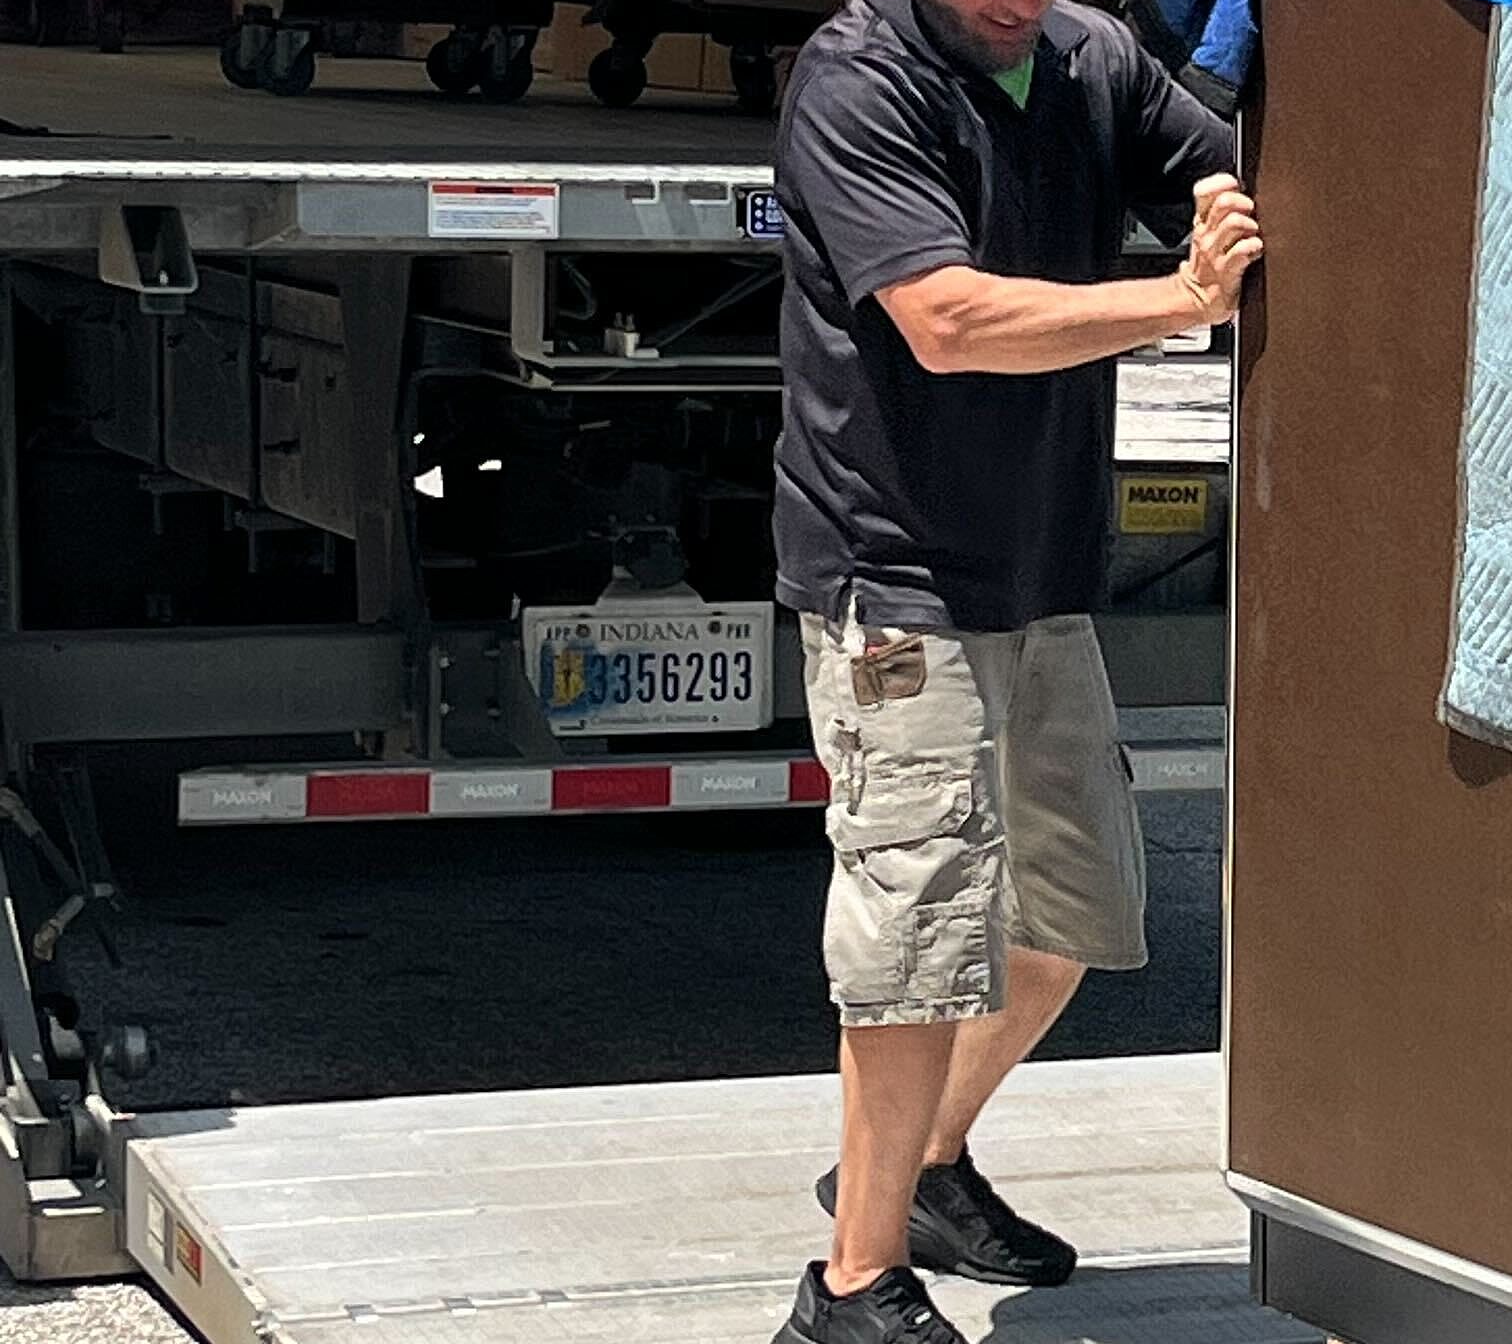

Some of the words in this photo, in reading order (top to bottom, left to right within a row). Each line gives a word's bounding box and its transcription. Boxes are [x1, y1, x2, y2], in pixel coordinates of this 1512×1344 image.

[1128, 485, 1199, 504] MAXON
[600, 622, 701, 642] INDIANA
[590, 650, 752, 704] 3356293
